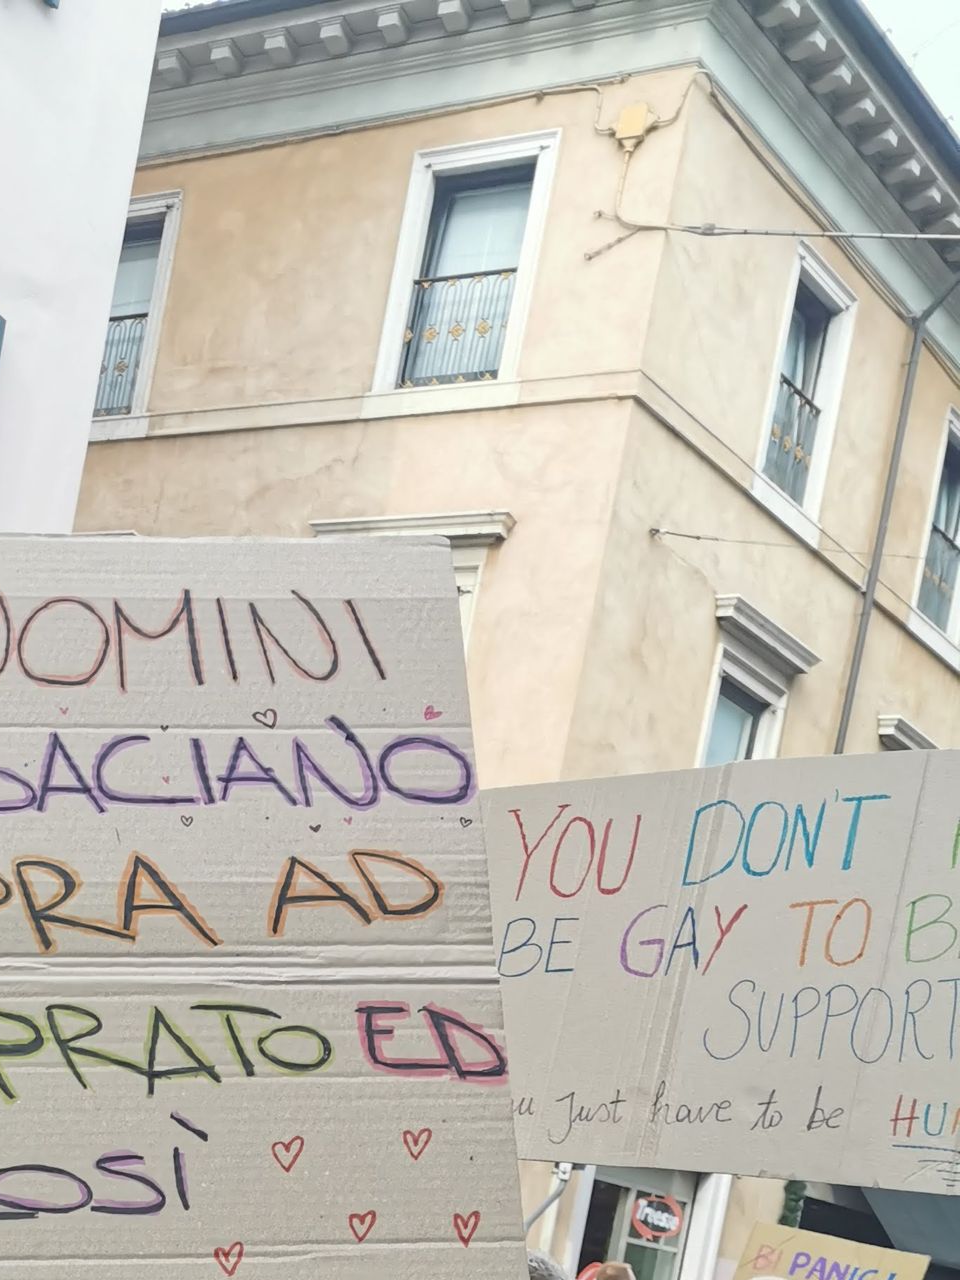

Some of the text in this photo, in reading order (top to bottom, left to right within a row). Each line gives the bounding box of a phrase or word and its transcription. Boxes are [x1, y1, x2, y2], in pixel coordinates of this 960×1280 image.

[507, 803, 642, 901] YOU
[682, 788, 892, 888] DON'T
[266, 848, 445, 937] AD
[497, 893, 960, 979] BE GAY TO B
[354, 1000, 510, 1085] ED
[650, 1080, 732, 1123] have
[751, 1089, 783, 1131] to
[806, 1085, 846, 1131] be
